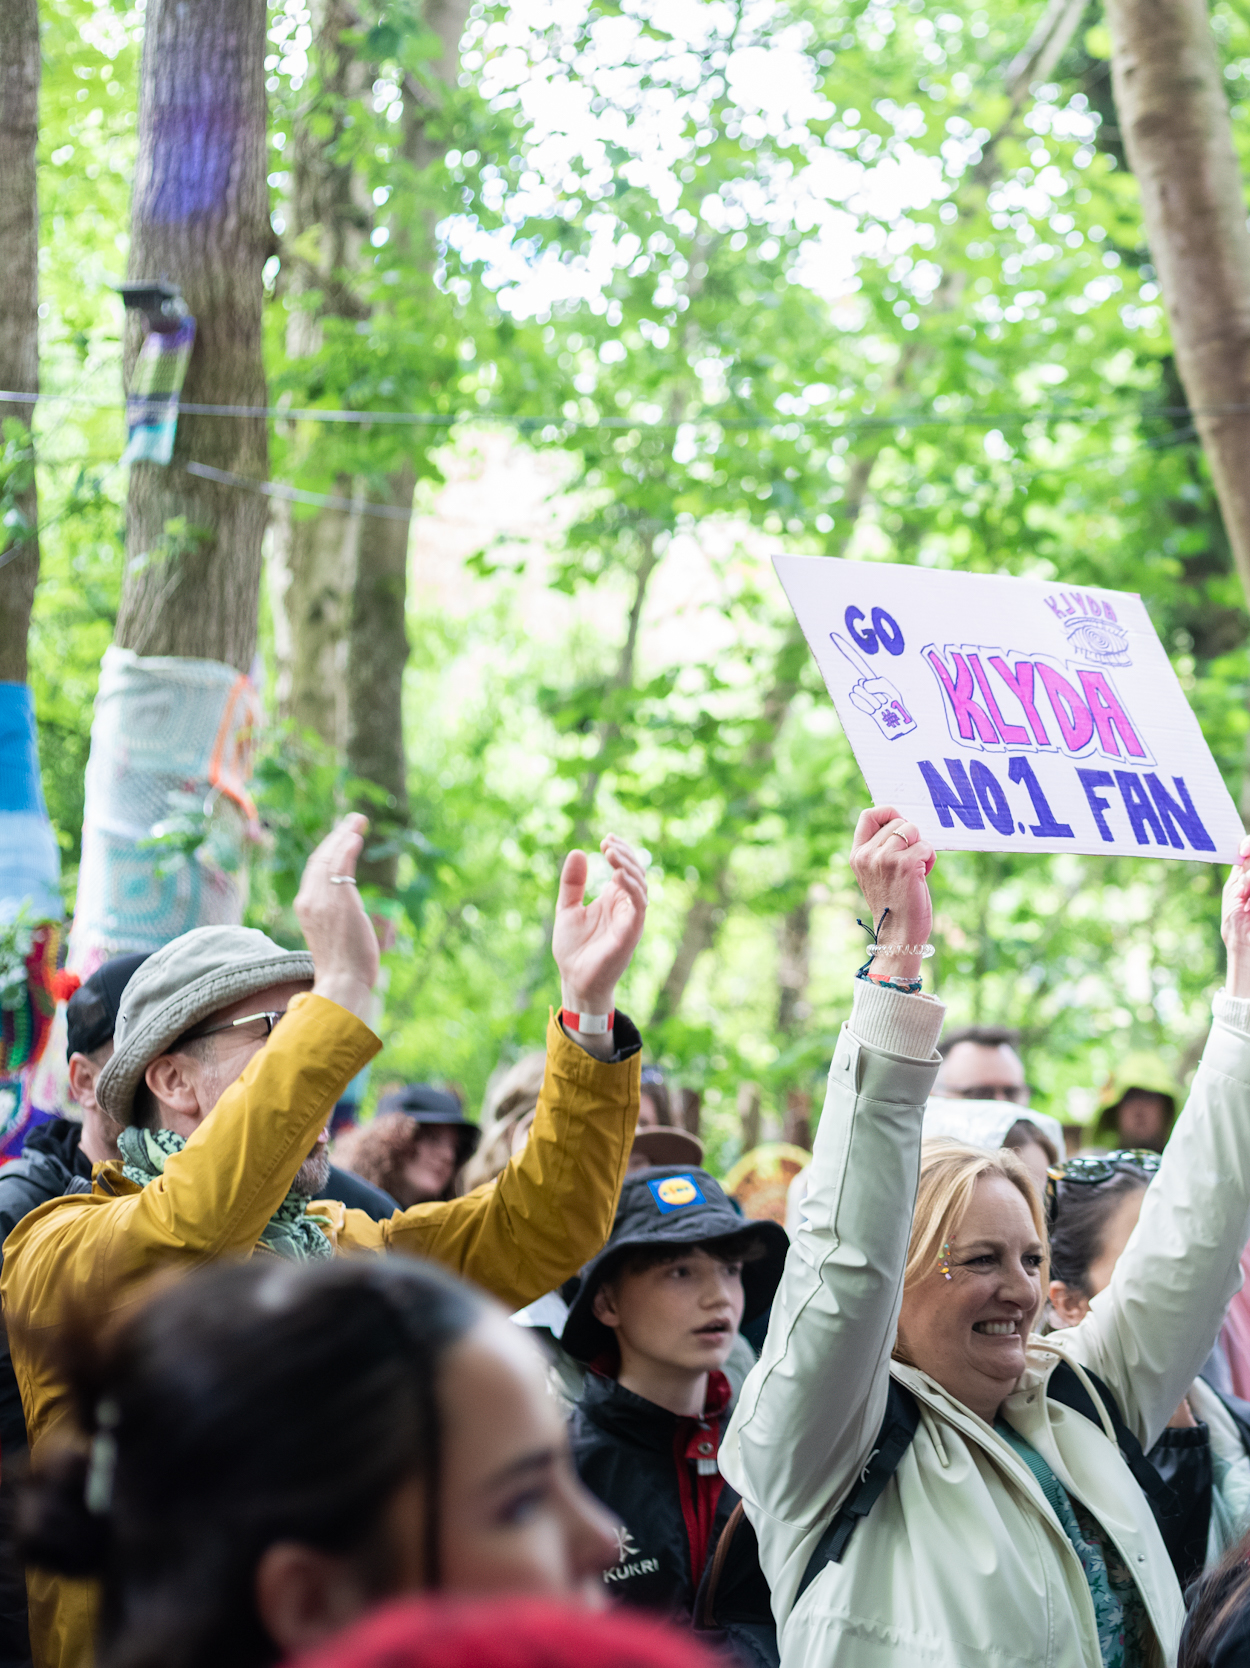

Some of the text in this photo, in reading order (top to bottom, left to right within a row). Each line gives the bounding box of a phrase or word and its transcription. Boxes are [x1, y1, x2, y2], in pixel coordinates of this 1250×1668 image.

[1043, 592, 1118, 623] KLYDA
[844, 604, 905, 656] GO
[881, 700, 912, 728] #1
[928, 650, 1147, 758] KLYDA
[916, 756, 1217, 852] NO.1 FAN
[602, 1557, 660, 1584] KUKRI
